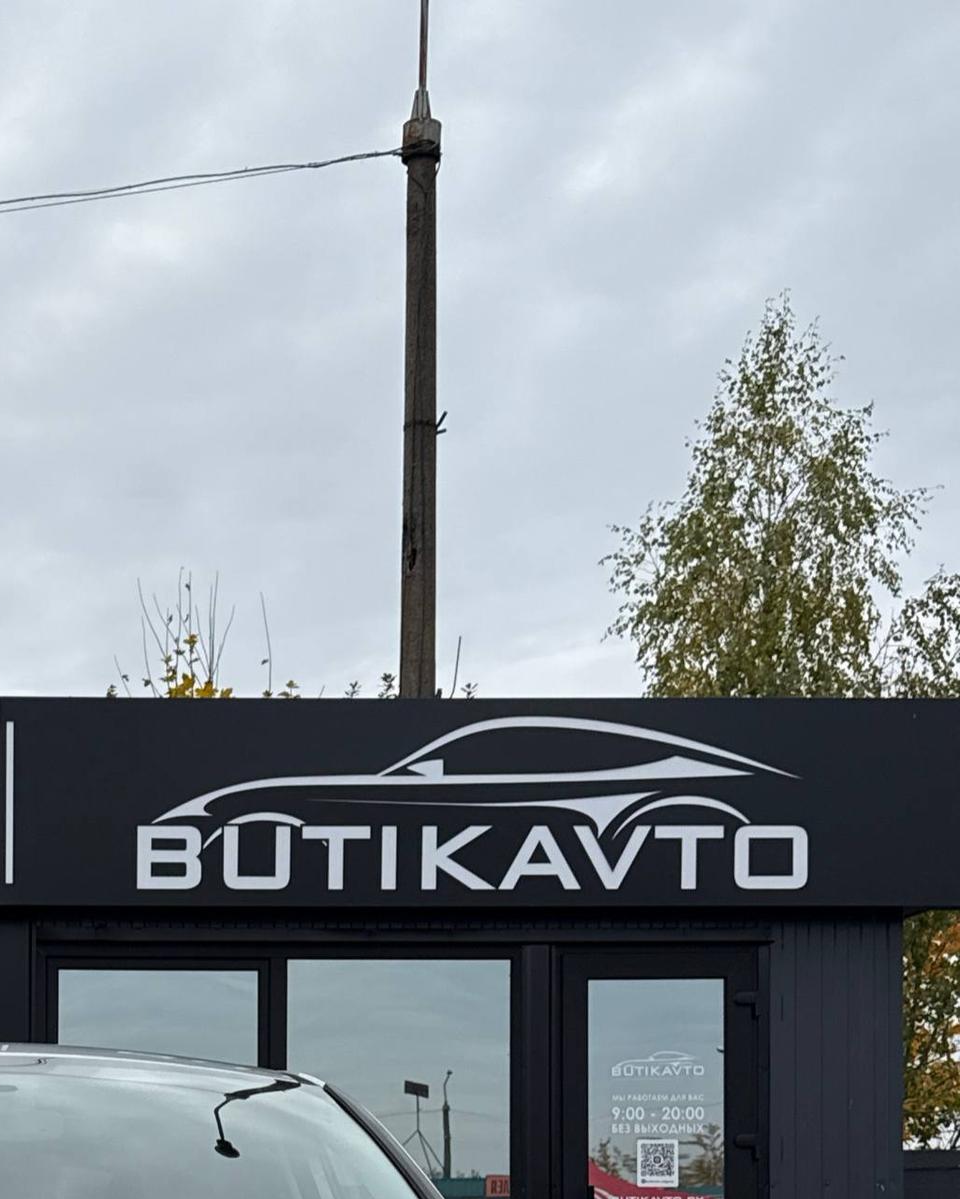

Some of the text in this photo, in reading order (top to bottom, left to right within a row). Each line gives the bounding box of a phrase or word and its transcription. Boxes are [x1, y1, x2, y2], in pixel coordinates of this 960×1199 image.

[136, 825, 809, 890] BUTIKAVTO
[611, 1065, 705, 1076] BUTIKAVTO
[612, 1106, 645, 1120] 9:00
[662, 1106, 705, 1120] 20:00
[611, 1123, 705, 1134] БЕЗ ВЫХОДНЫХ
